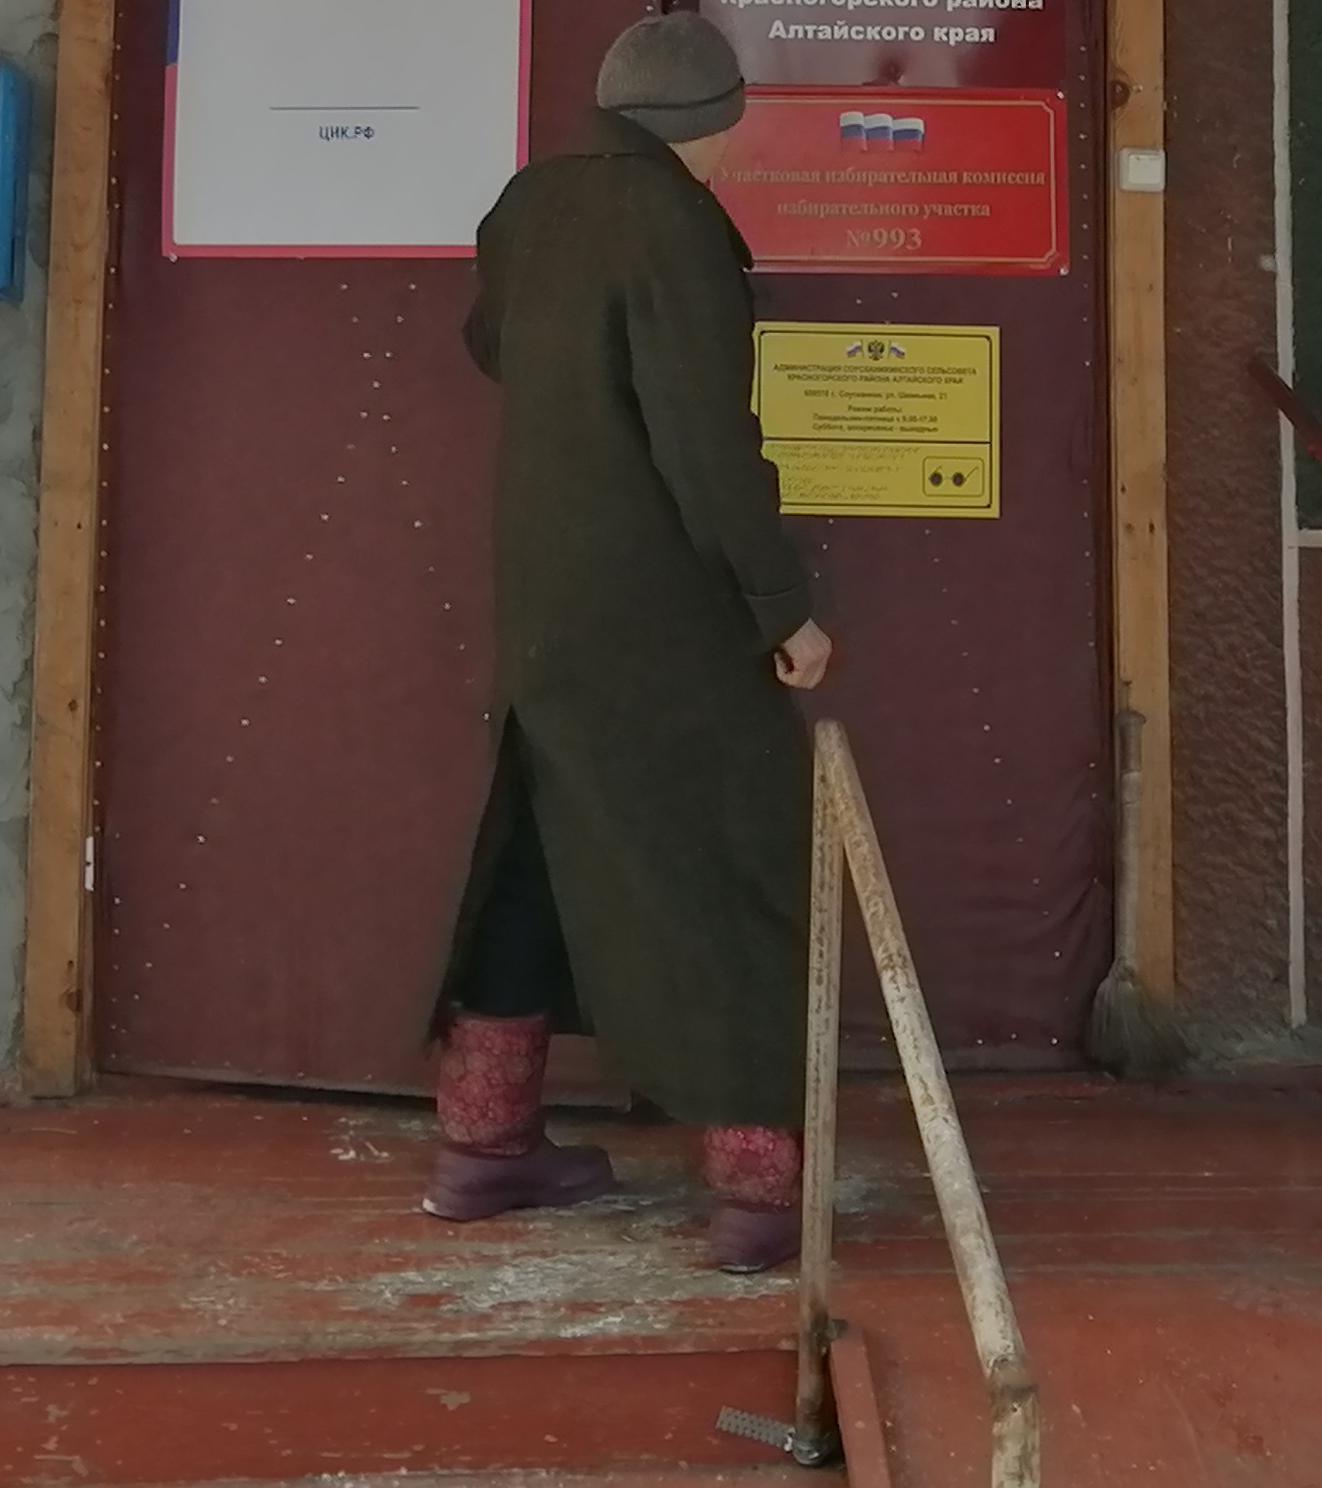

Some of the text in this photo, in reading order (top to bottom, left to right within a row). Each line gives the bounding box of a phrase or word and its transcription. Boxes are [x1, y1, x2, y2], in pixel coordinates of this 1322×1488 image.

[769, 20, 996, 47] Алтайского края
[825, 167, 958, 187] избирательная
[962, 170, 1046, 186] комиссия
[777, 199, 991, 220] избирательного участка
[846, 227, 922, 250] №993
